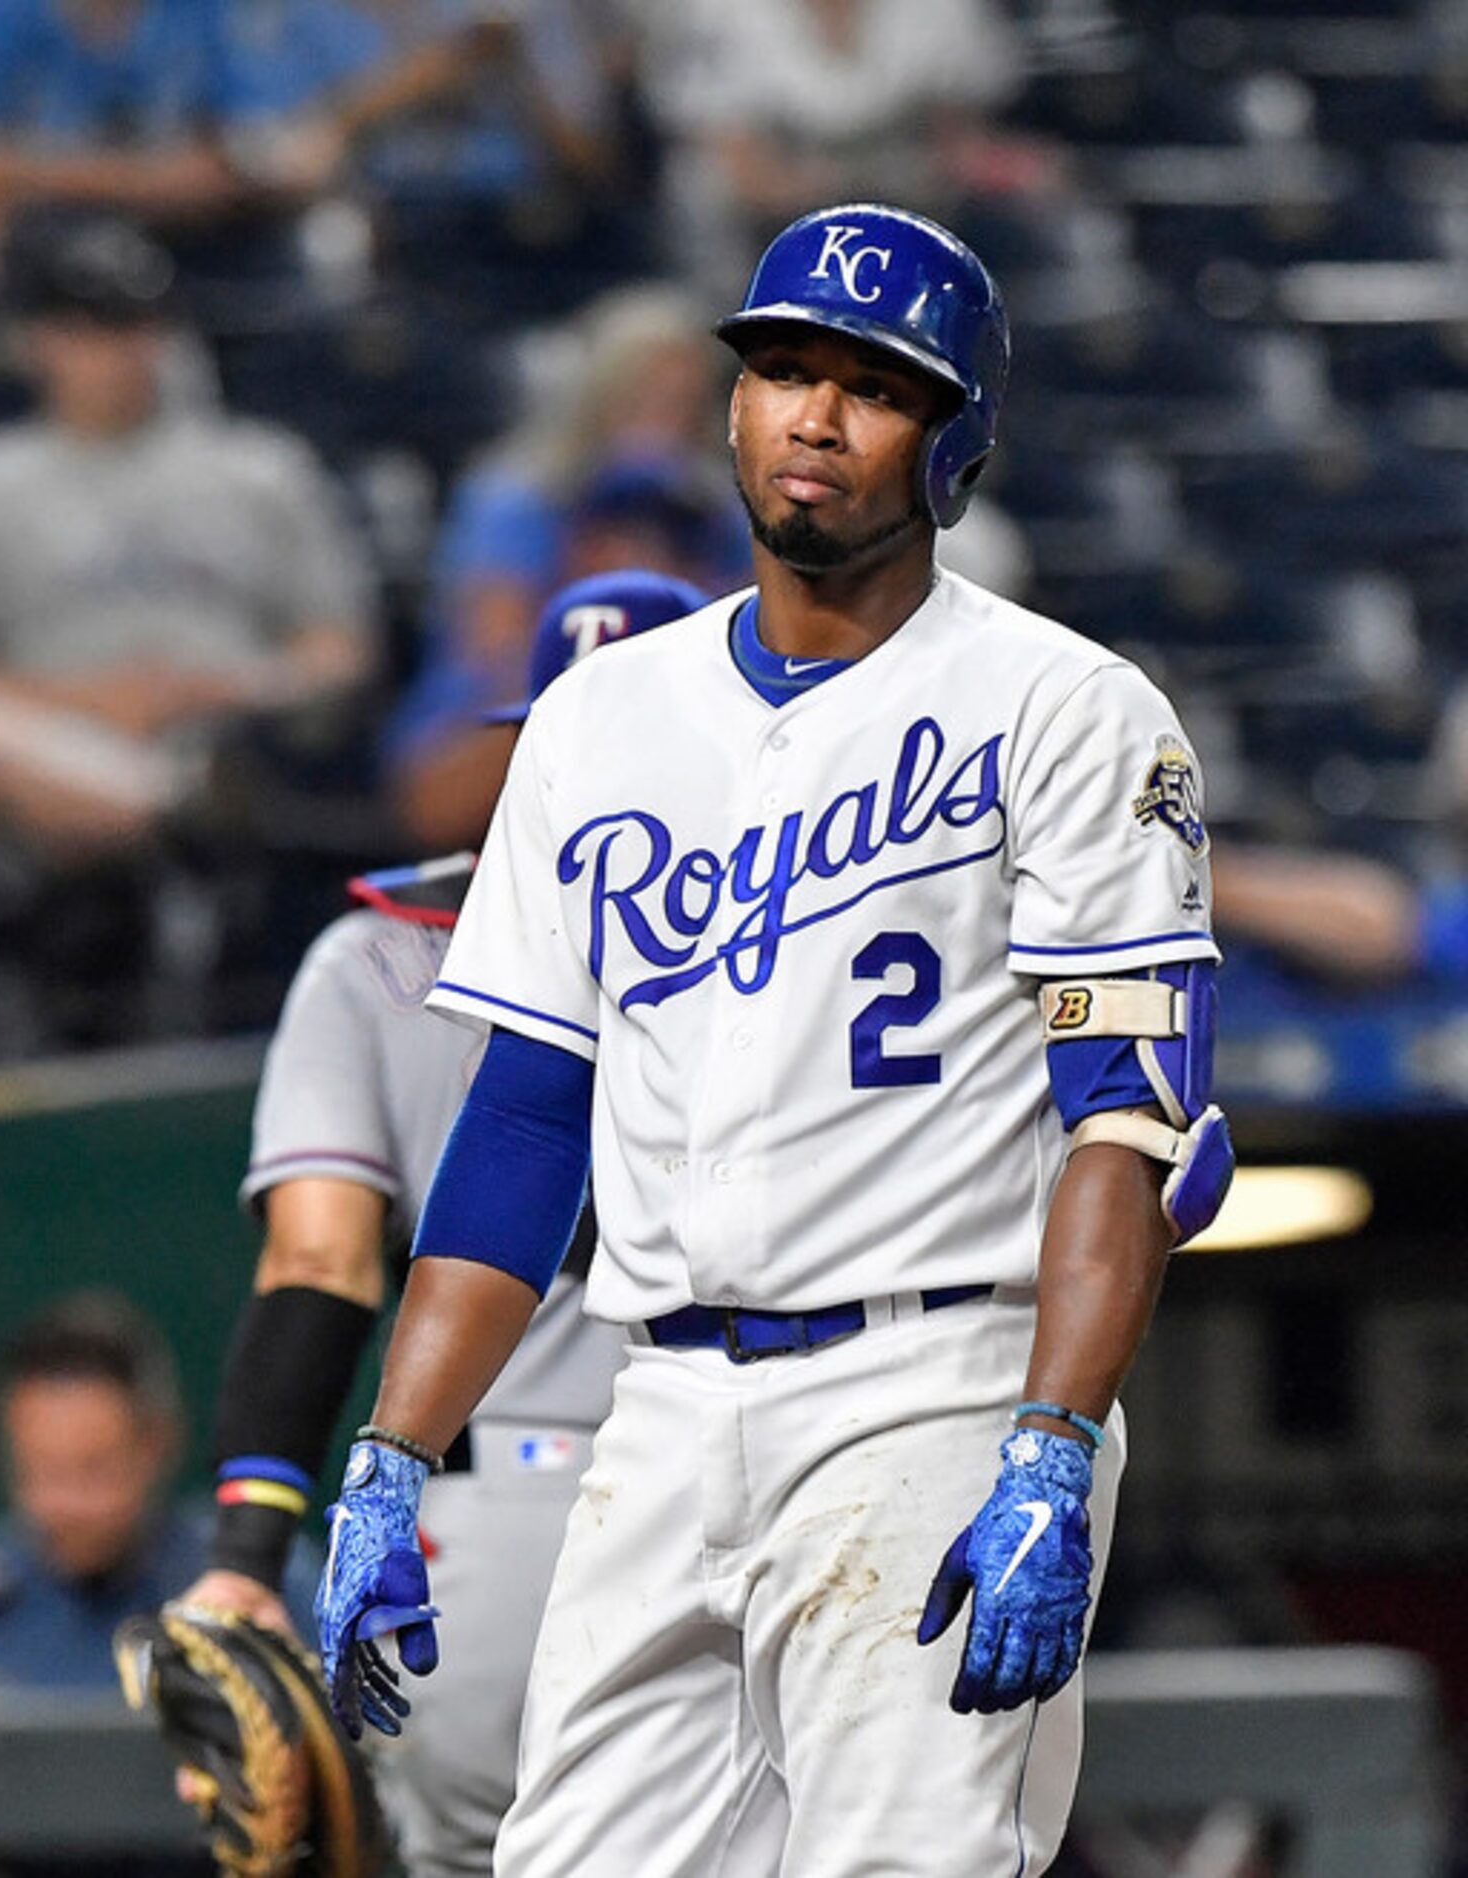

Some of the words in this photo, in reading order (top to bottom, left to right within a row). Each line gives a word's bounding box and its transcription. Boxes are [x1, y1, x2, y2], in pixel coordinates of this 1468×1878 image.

[807, 225, 892, 304] KC
[561, 605, 630, 667] T
[557, 716, 1006, 995] Royals
[849, 931, 942, 1090] 2
[1049, 987, 1092, 1030] B
